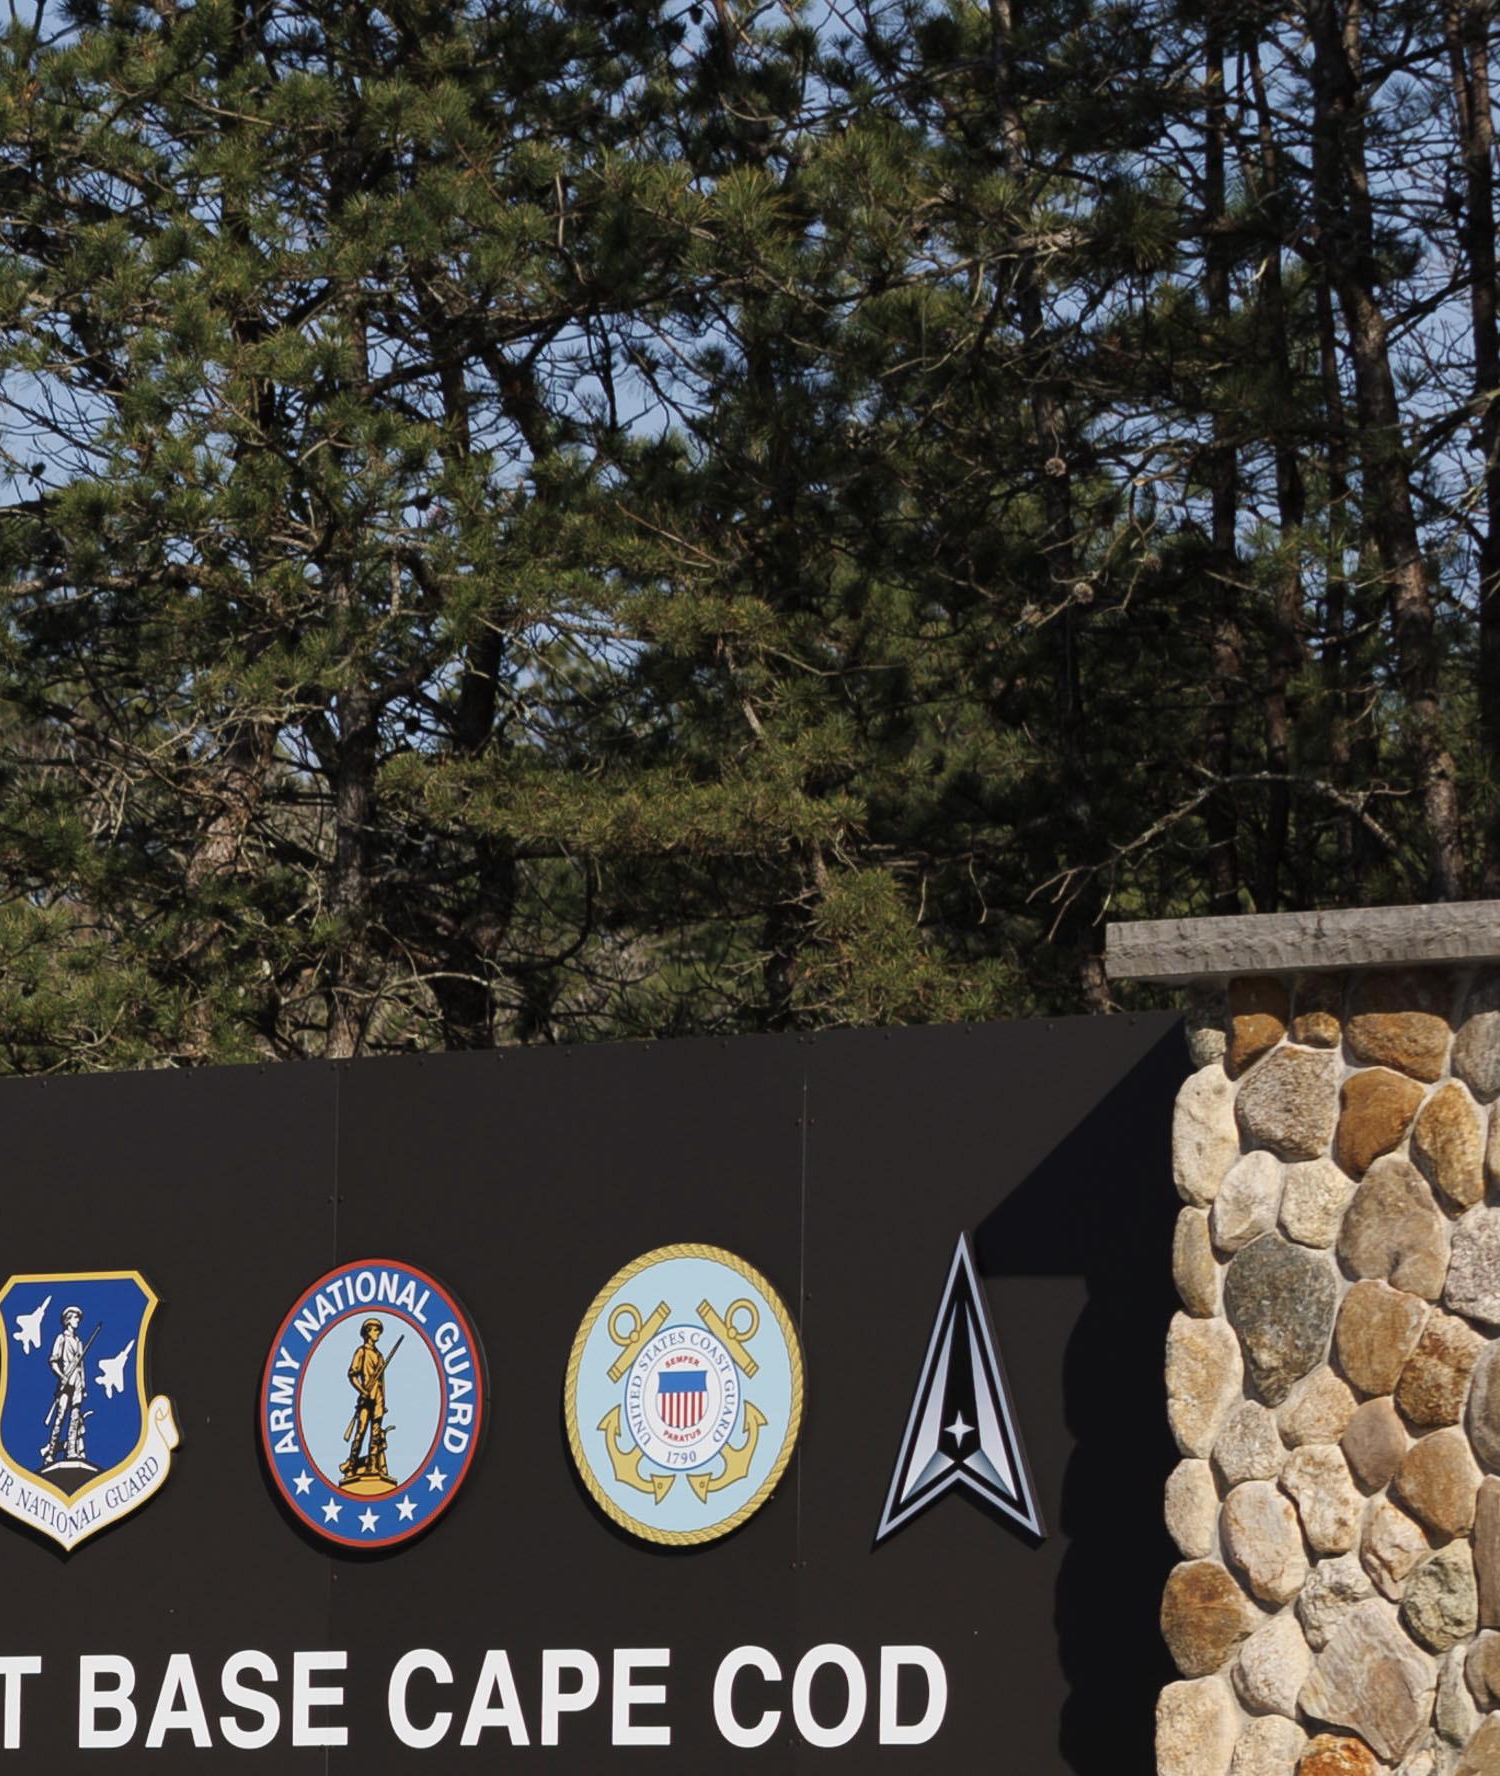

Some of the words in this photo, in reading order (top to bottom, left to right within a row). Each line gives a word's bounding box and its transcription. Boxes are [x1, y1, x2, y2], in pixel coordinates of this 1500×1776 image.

[269, 1347, 301, 1454] ARMY
[293, 1270, 430, 1343] NATIONAL
[434, 1321, 473, 1454] GUARD
[638, 1331, 686, 1372] STATES
[665, 1355, 701, 1369] SEMPER
[690, 1332, 731, 1373] COAST
[630, 1375, 652, 1447] UNITED
[663, 1428, 702, 1443] PARATUS
[712, 1379, 735, 1444] GUARD
[666, 1451, 697, 1465] 1790
[16, 1487, 101, 1539] NATIONAL
[105, 1456, 159, 1509] GUARD
[78, 1650, 349, 1749] BASE
[387, 1648, 671, 1748] CAPE
[713, 1644, 948, 1748] COD
